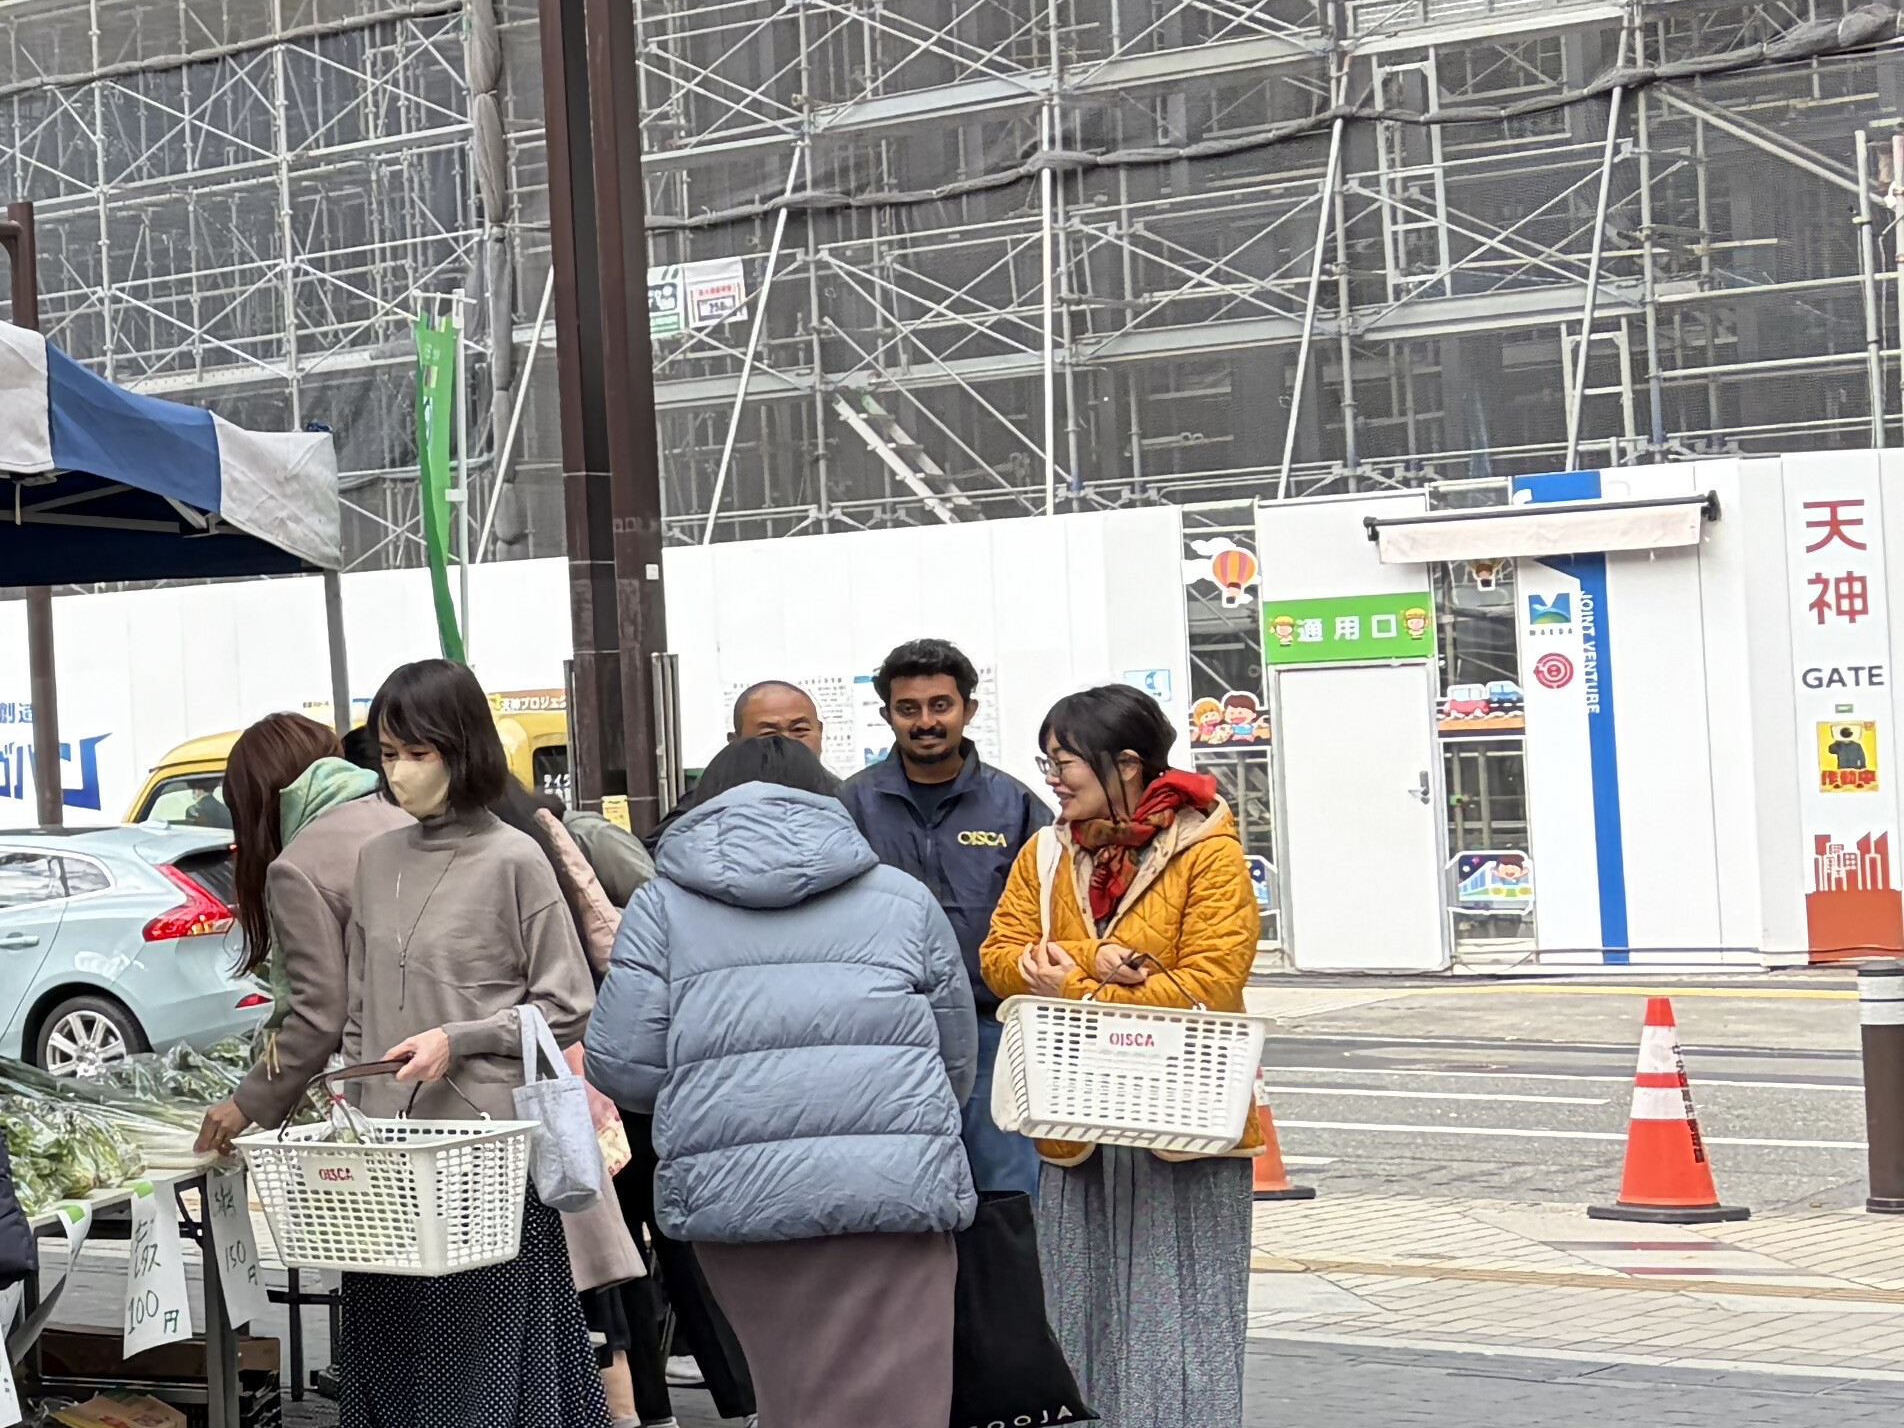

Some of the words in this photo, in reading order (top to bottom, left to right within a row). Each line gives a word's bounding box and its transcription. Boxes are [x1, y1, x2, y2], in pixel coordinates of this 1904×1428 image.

[1803, 499, 1869, 624] 天神
[1580, 590, 1595, 636] JOINT
[1296, 614, 1397, 642] 通用口
[1583, 639, 1600, 714] VENTURE
[1802, 665, 1885, 689] GATE
[958, 831, 1007, 848] OISCA
[1109, 1033, 1154, 1047] OISCA
[318, 1167, 355, 1181] OISCA
